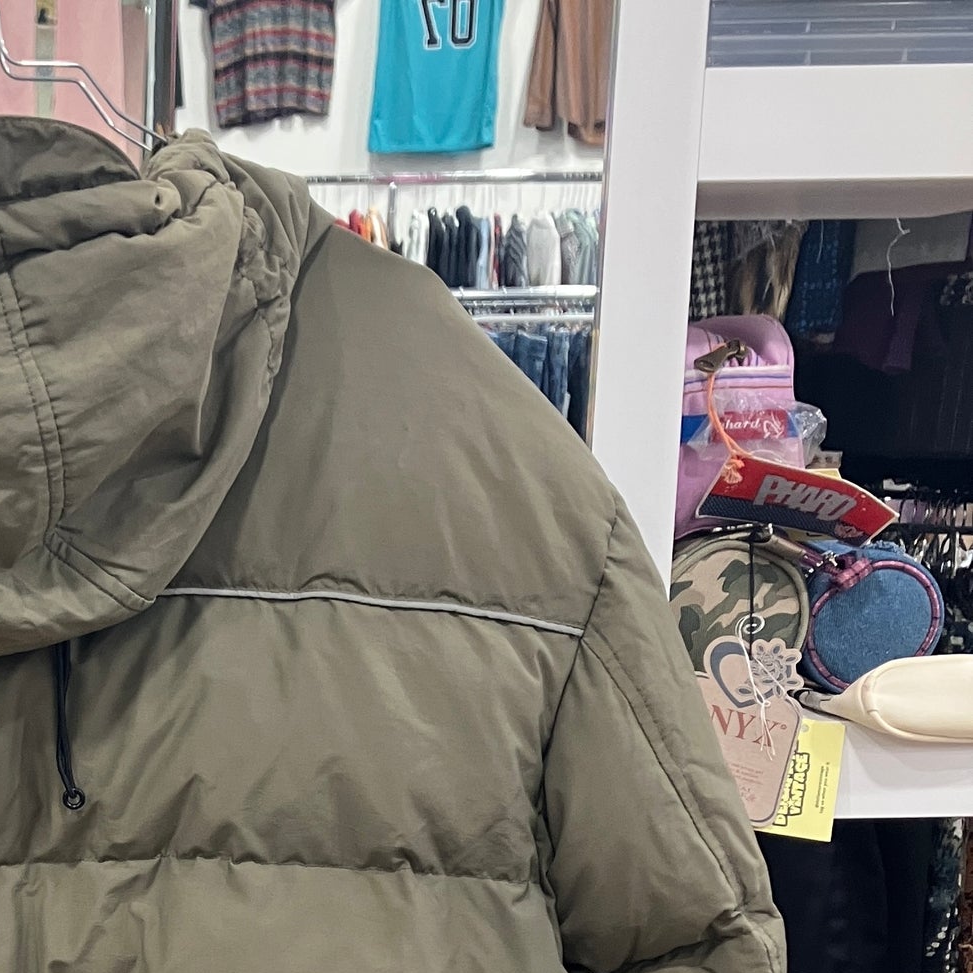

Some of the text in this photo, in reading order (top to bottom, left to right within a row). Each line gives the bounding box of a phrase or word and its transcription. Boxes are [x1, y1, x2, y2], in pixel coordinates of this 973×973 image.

[721, 418, 761, 430] hard
[753, 474, 857, 521] PHARD
[711, 704, 780, 748] NYX
